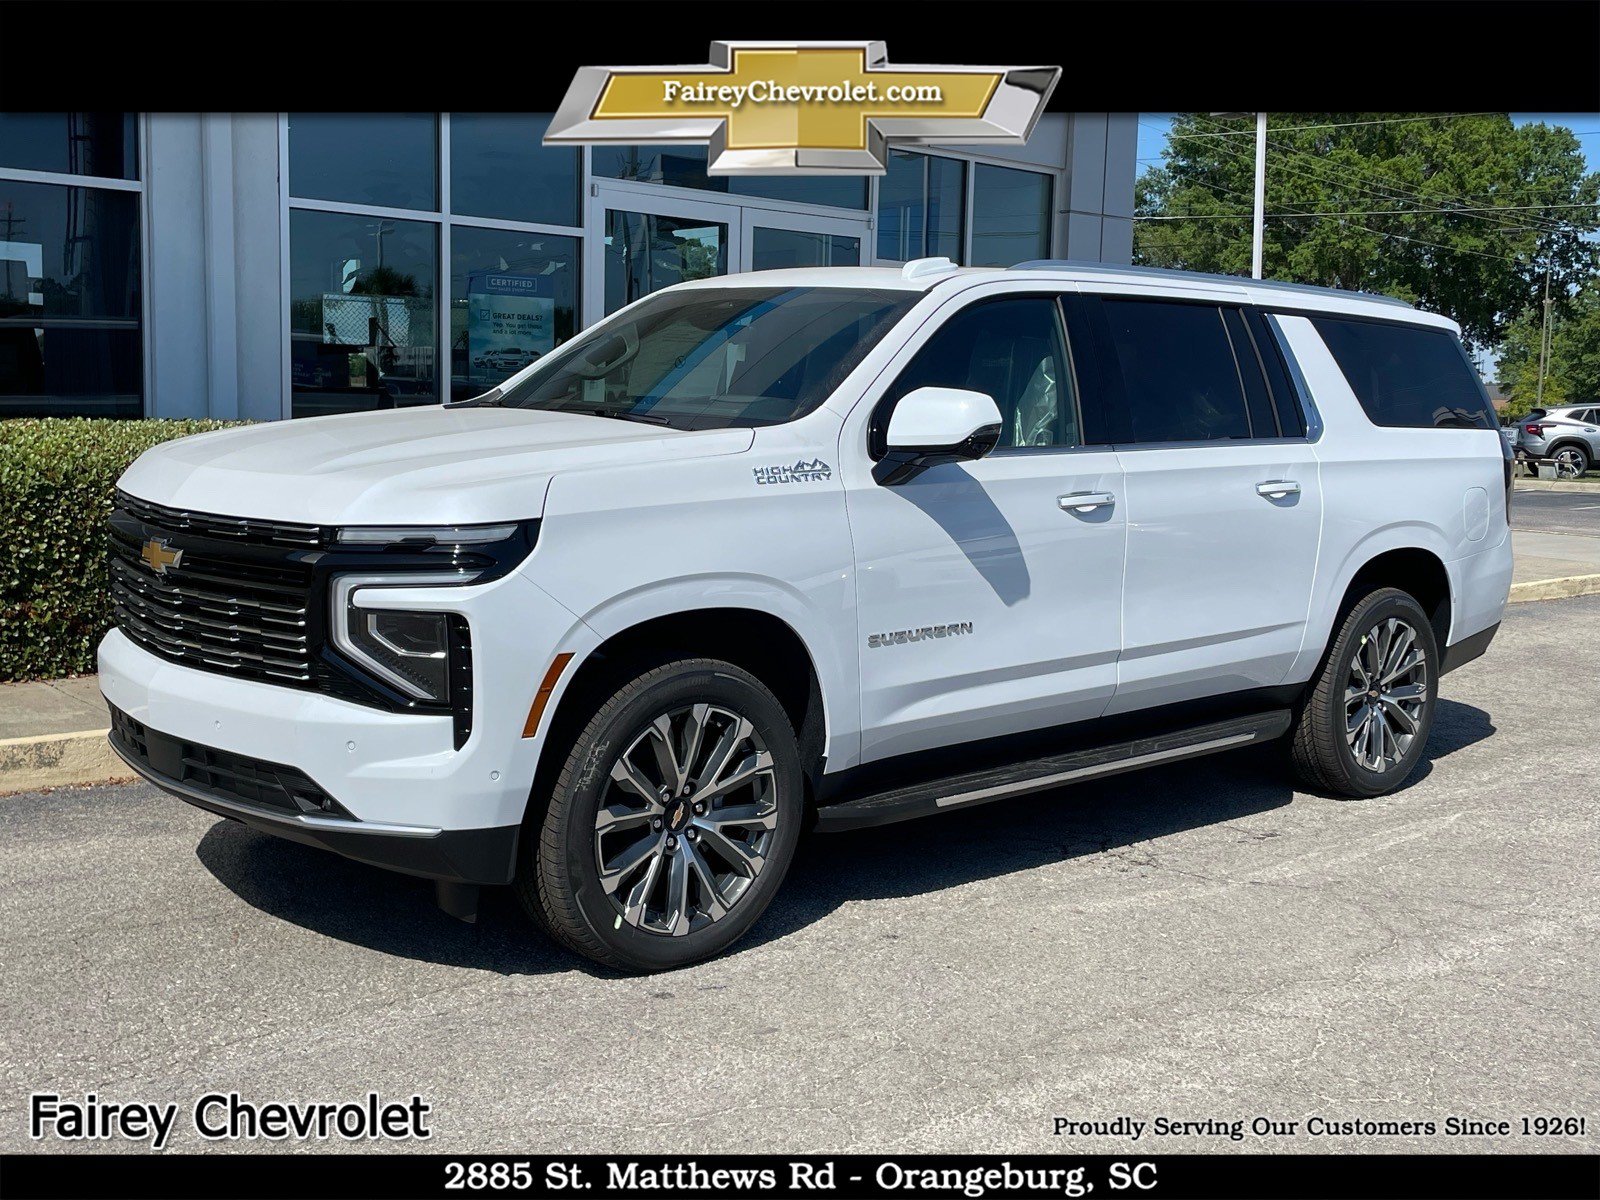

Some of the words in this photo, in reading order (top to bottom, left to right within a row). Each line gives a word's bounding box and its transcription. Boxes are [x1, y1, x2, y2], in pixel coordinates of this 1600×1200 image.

[490, 278, 533, 288] CERTIFIED
[492, 312, 515, 320] GREAT
[752, 465, 793, 476] HIGH
[756, 472, 832, 485] COUNTRY
[867, 621, 974, 649] SUBURBAN
